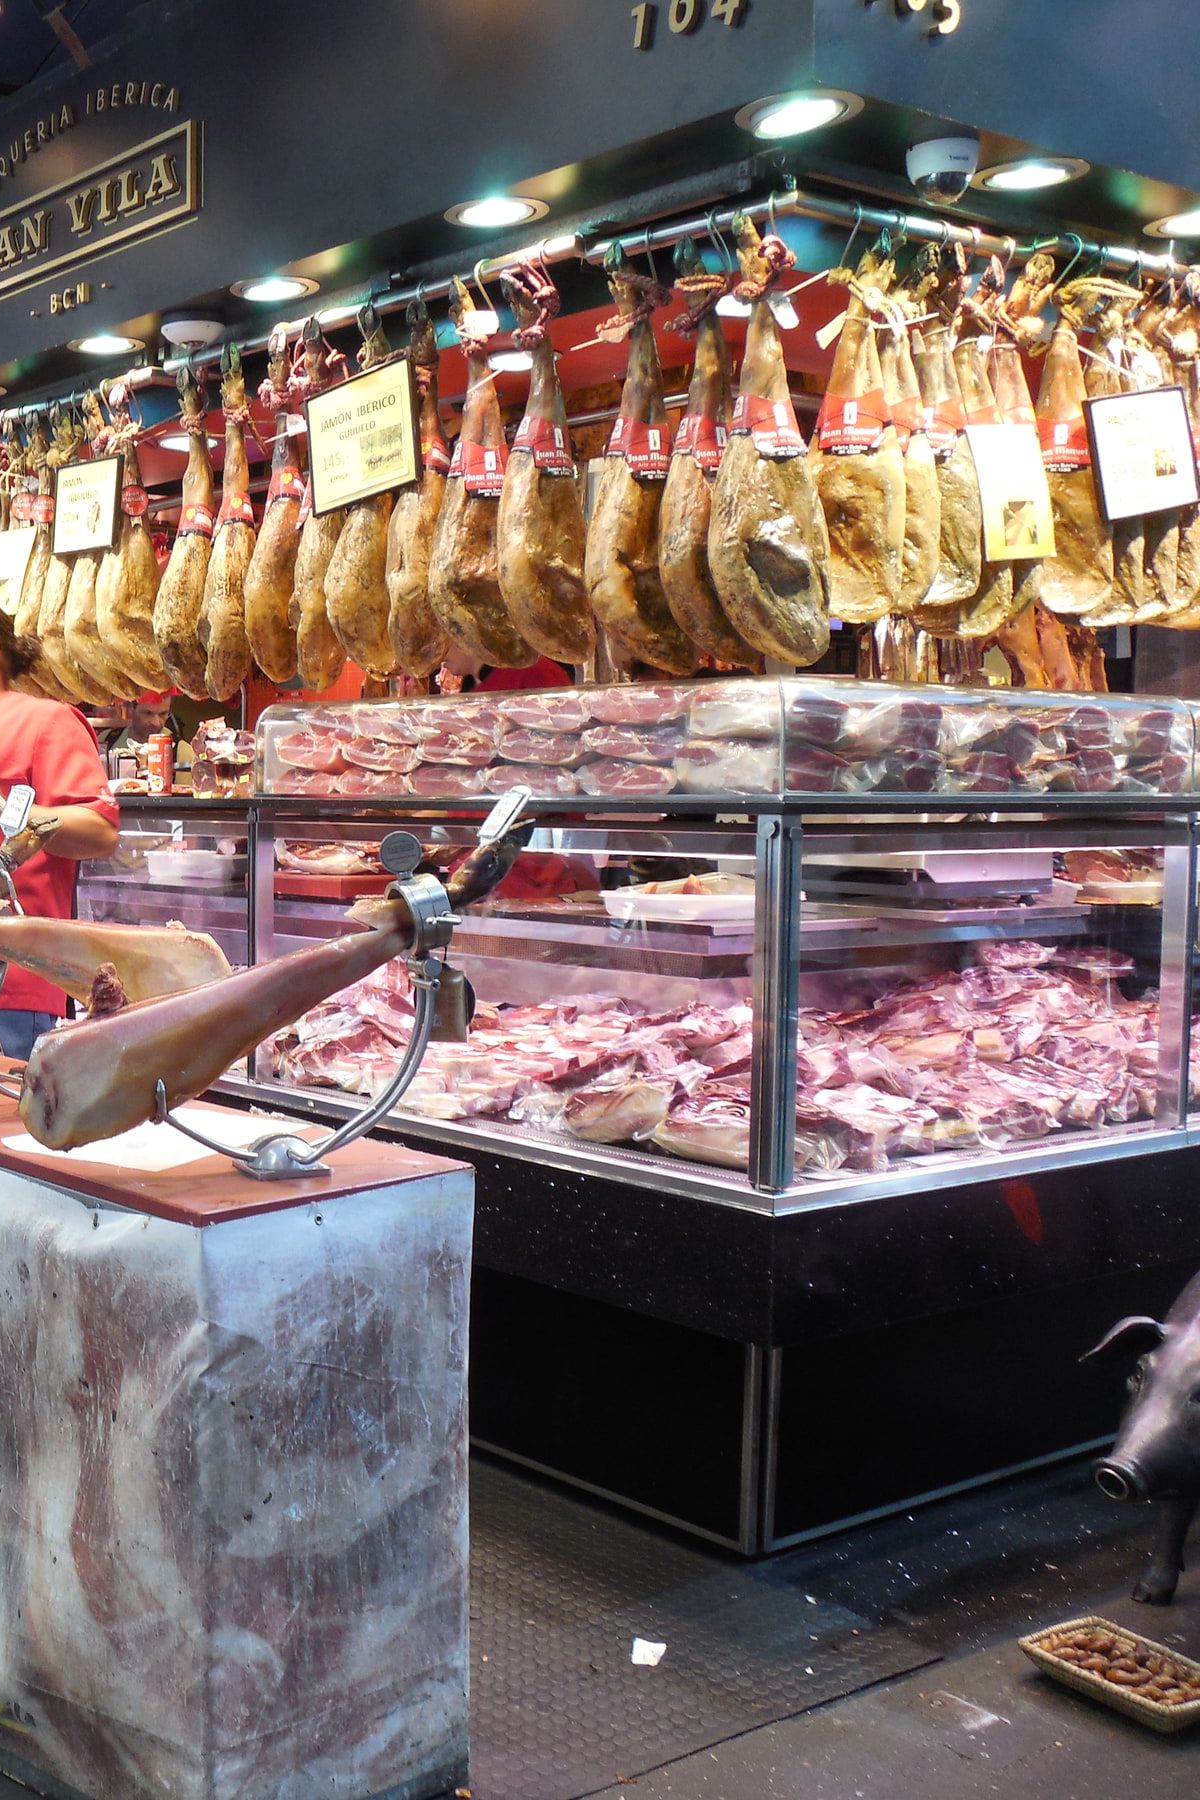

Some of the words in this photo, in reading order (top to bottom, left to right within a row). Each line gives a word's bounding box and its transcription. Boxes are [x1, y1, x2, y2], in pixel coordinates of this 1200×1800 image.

[86, 81, 177, 115] IBERICA
[66, 153, 180, 238] VILA
[50, 282, 89, 313] BCN
[535, 450, 555, 460] Juan
[628, 454, 649, 463] Juan
